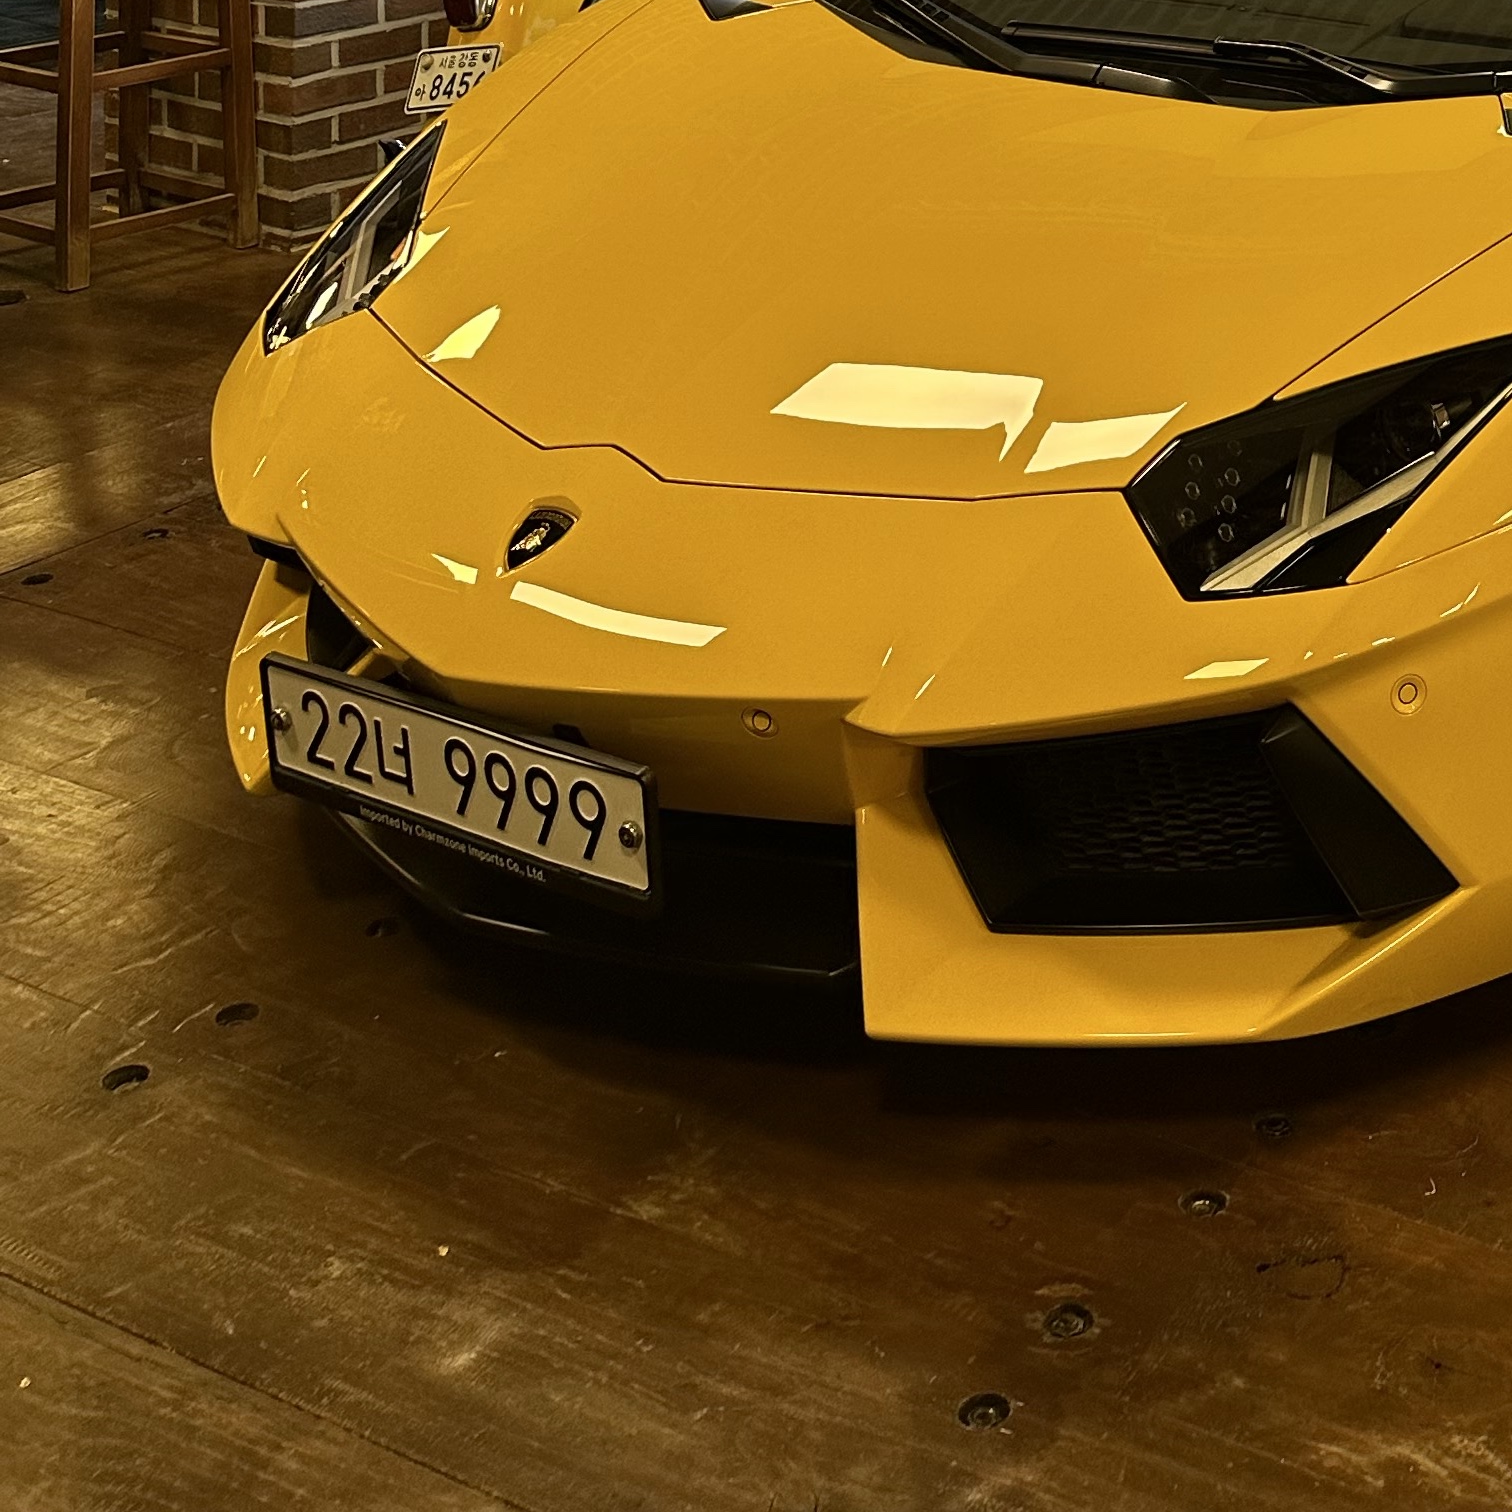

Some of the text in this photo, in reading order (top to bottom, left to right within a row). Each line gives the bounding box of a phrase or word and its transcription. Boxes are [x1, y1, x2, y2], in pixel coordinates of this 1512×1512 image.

[301, 688, 607, 860] 22너 9999
[360, 805, 401, 829] Imported
[402, 819, 413, 836] by
[468, 844, 505, 868] Imports
